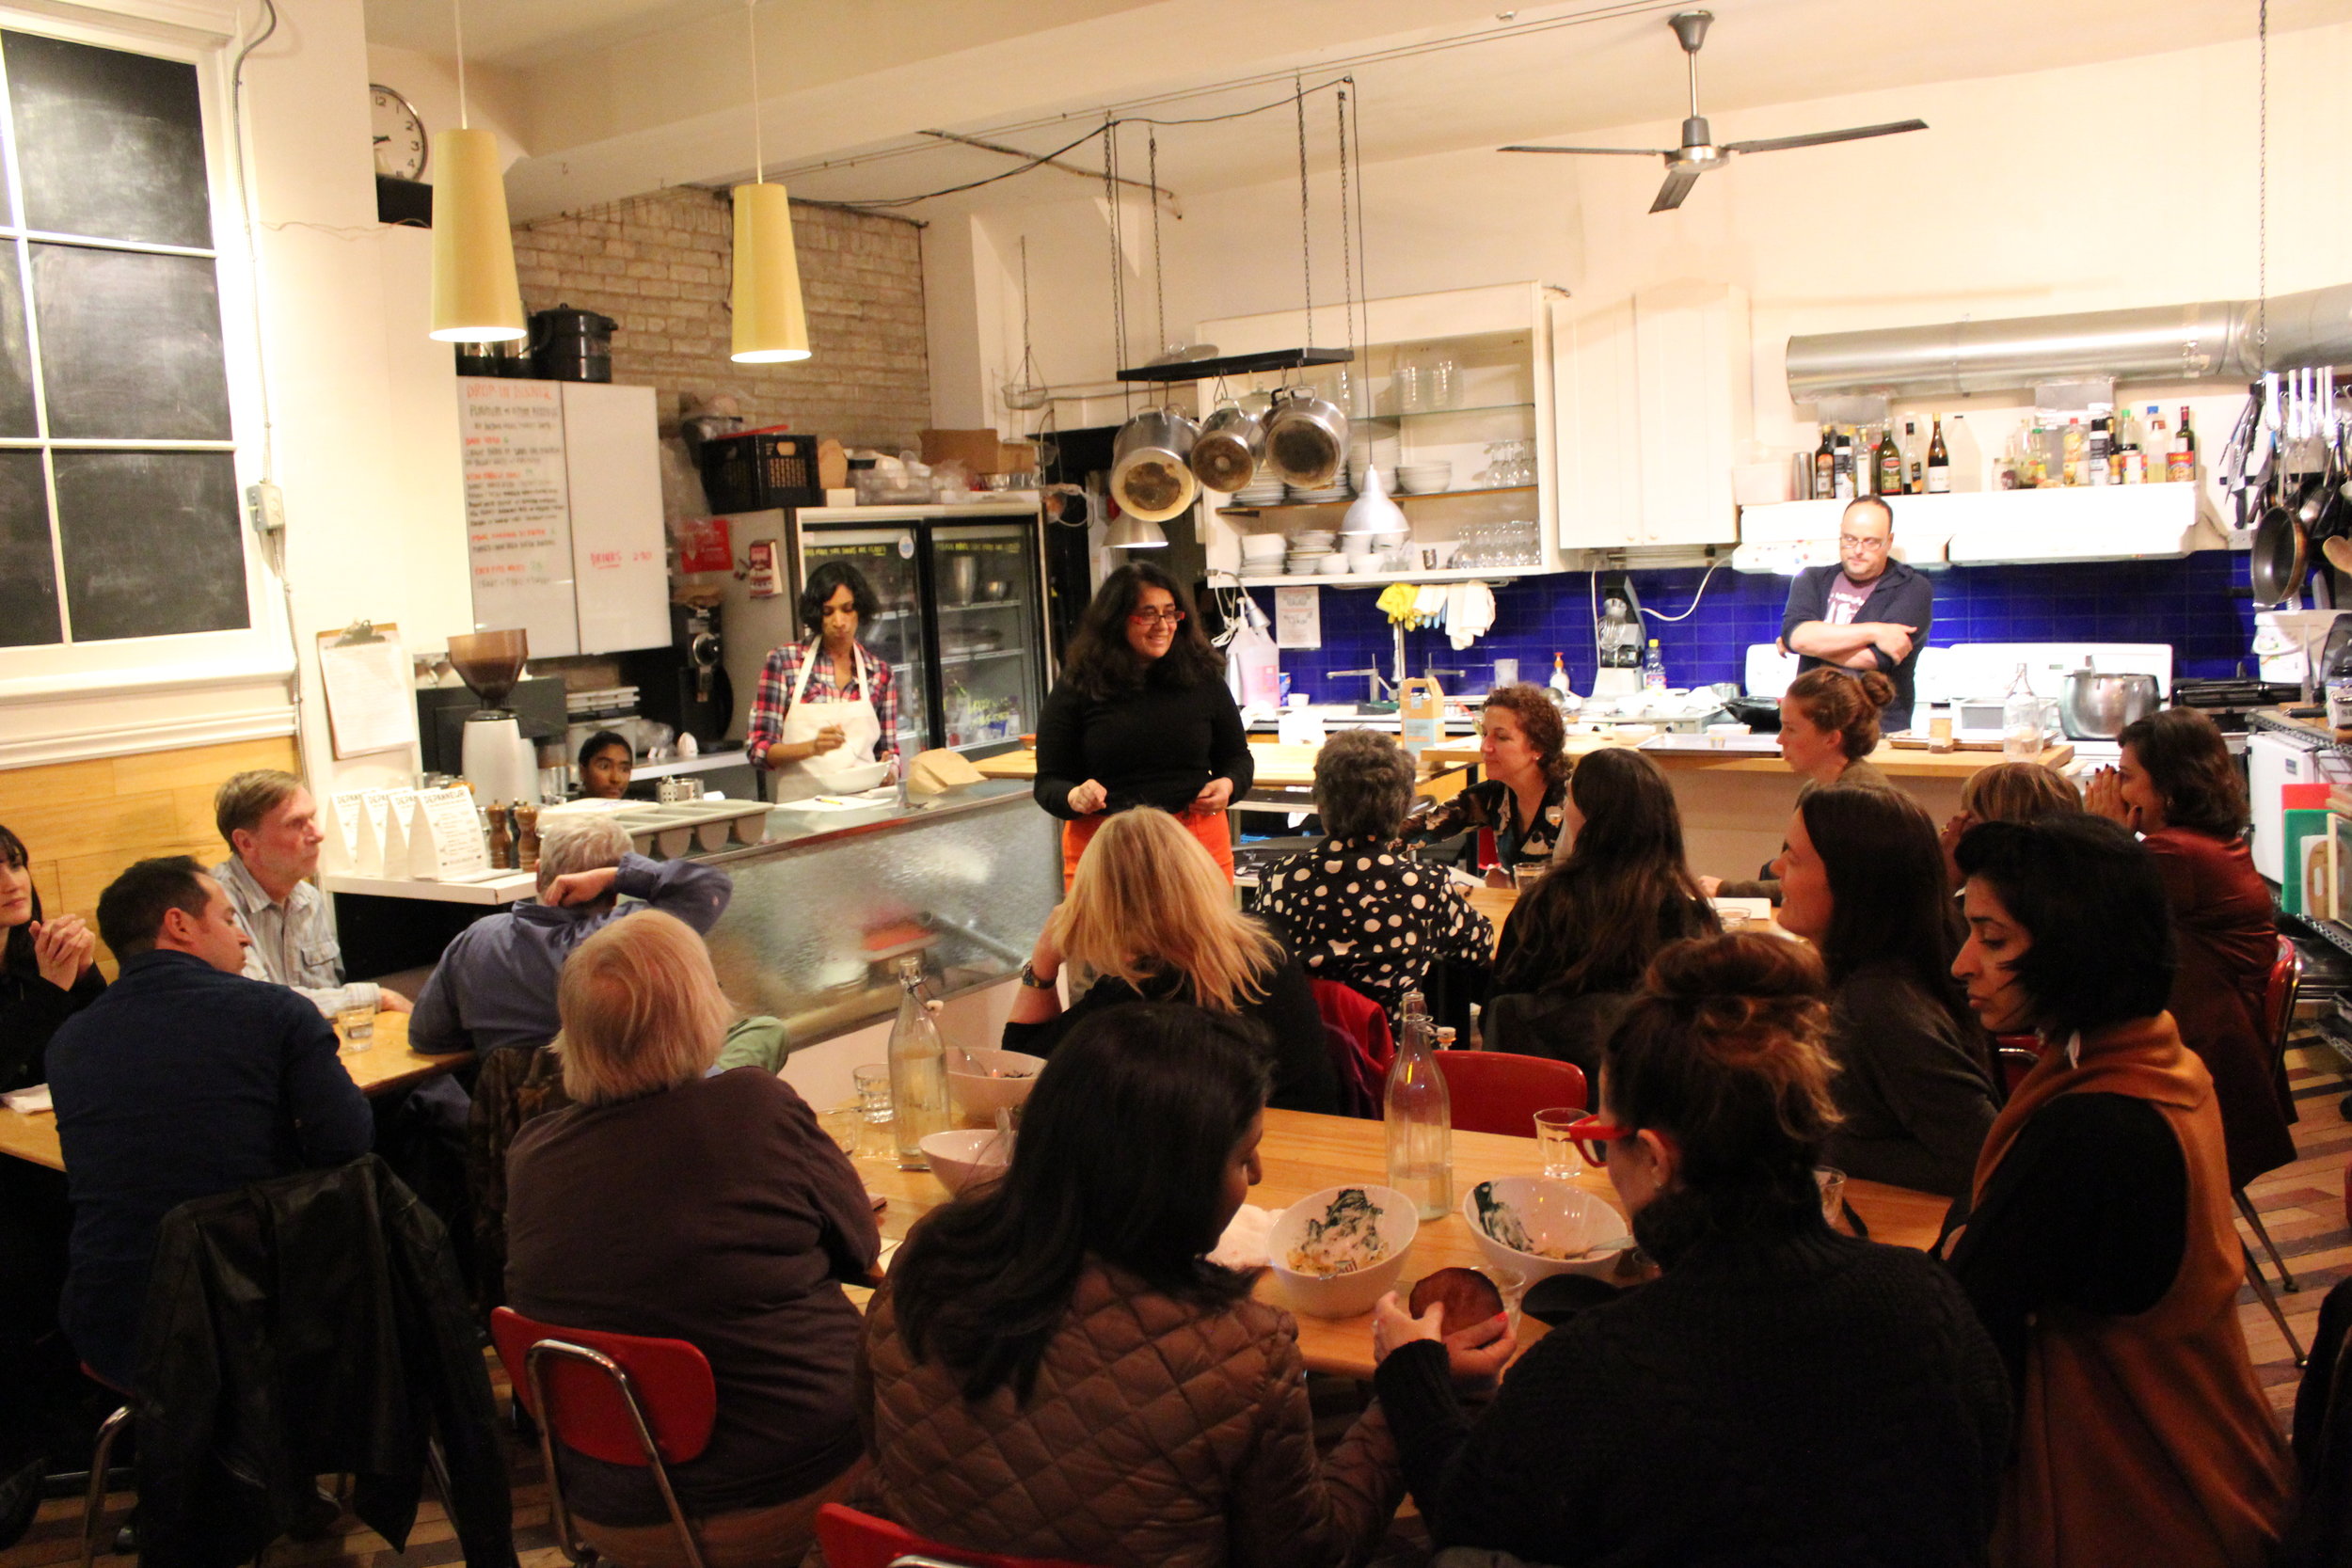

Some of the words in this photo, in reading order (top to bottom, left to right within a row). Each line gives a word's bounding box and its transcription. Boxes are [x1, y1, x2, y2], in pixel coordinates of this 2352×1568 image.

[375, 96, 386, 106] 12
[405, 120, 414, 131] 2
[410, 140, 420, 151] 3
[407, 158, 415, 168] 4
